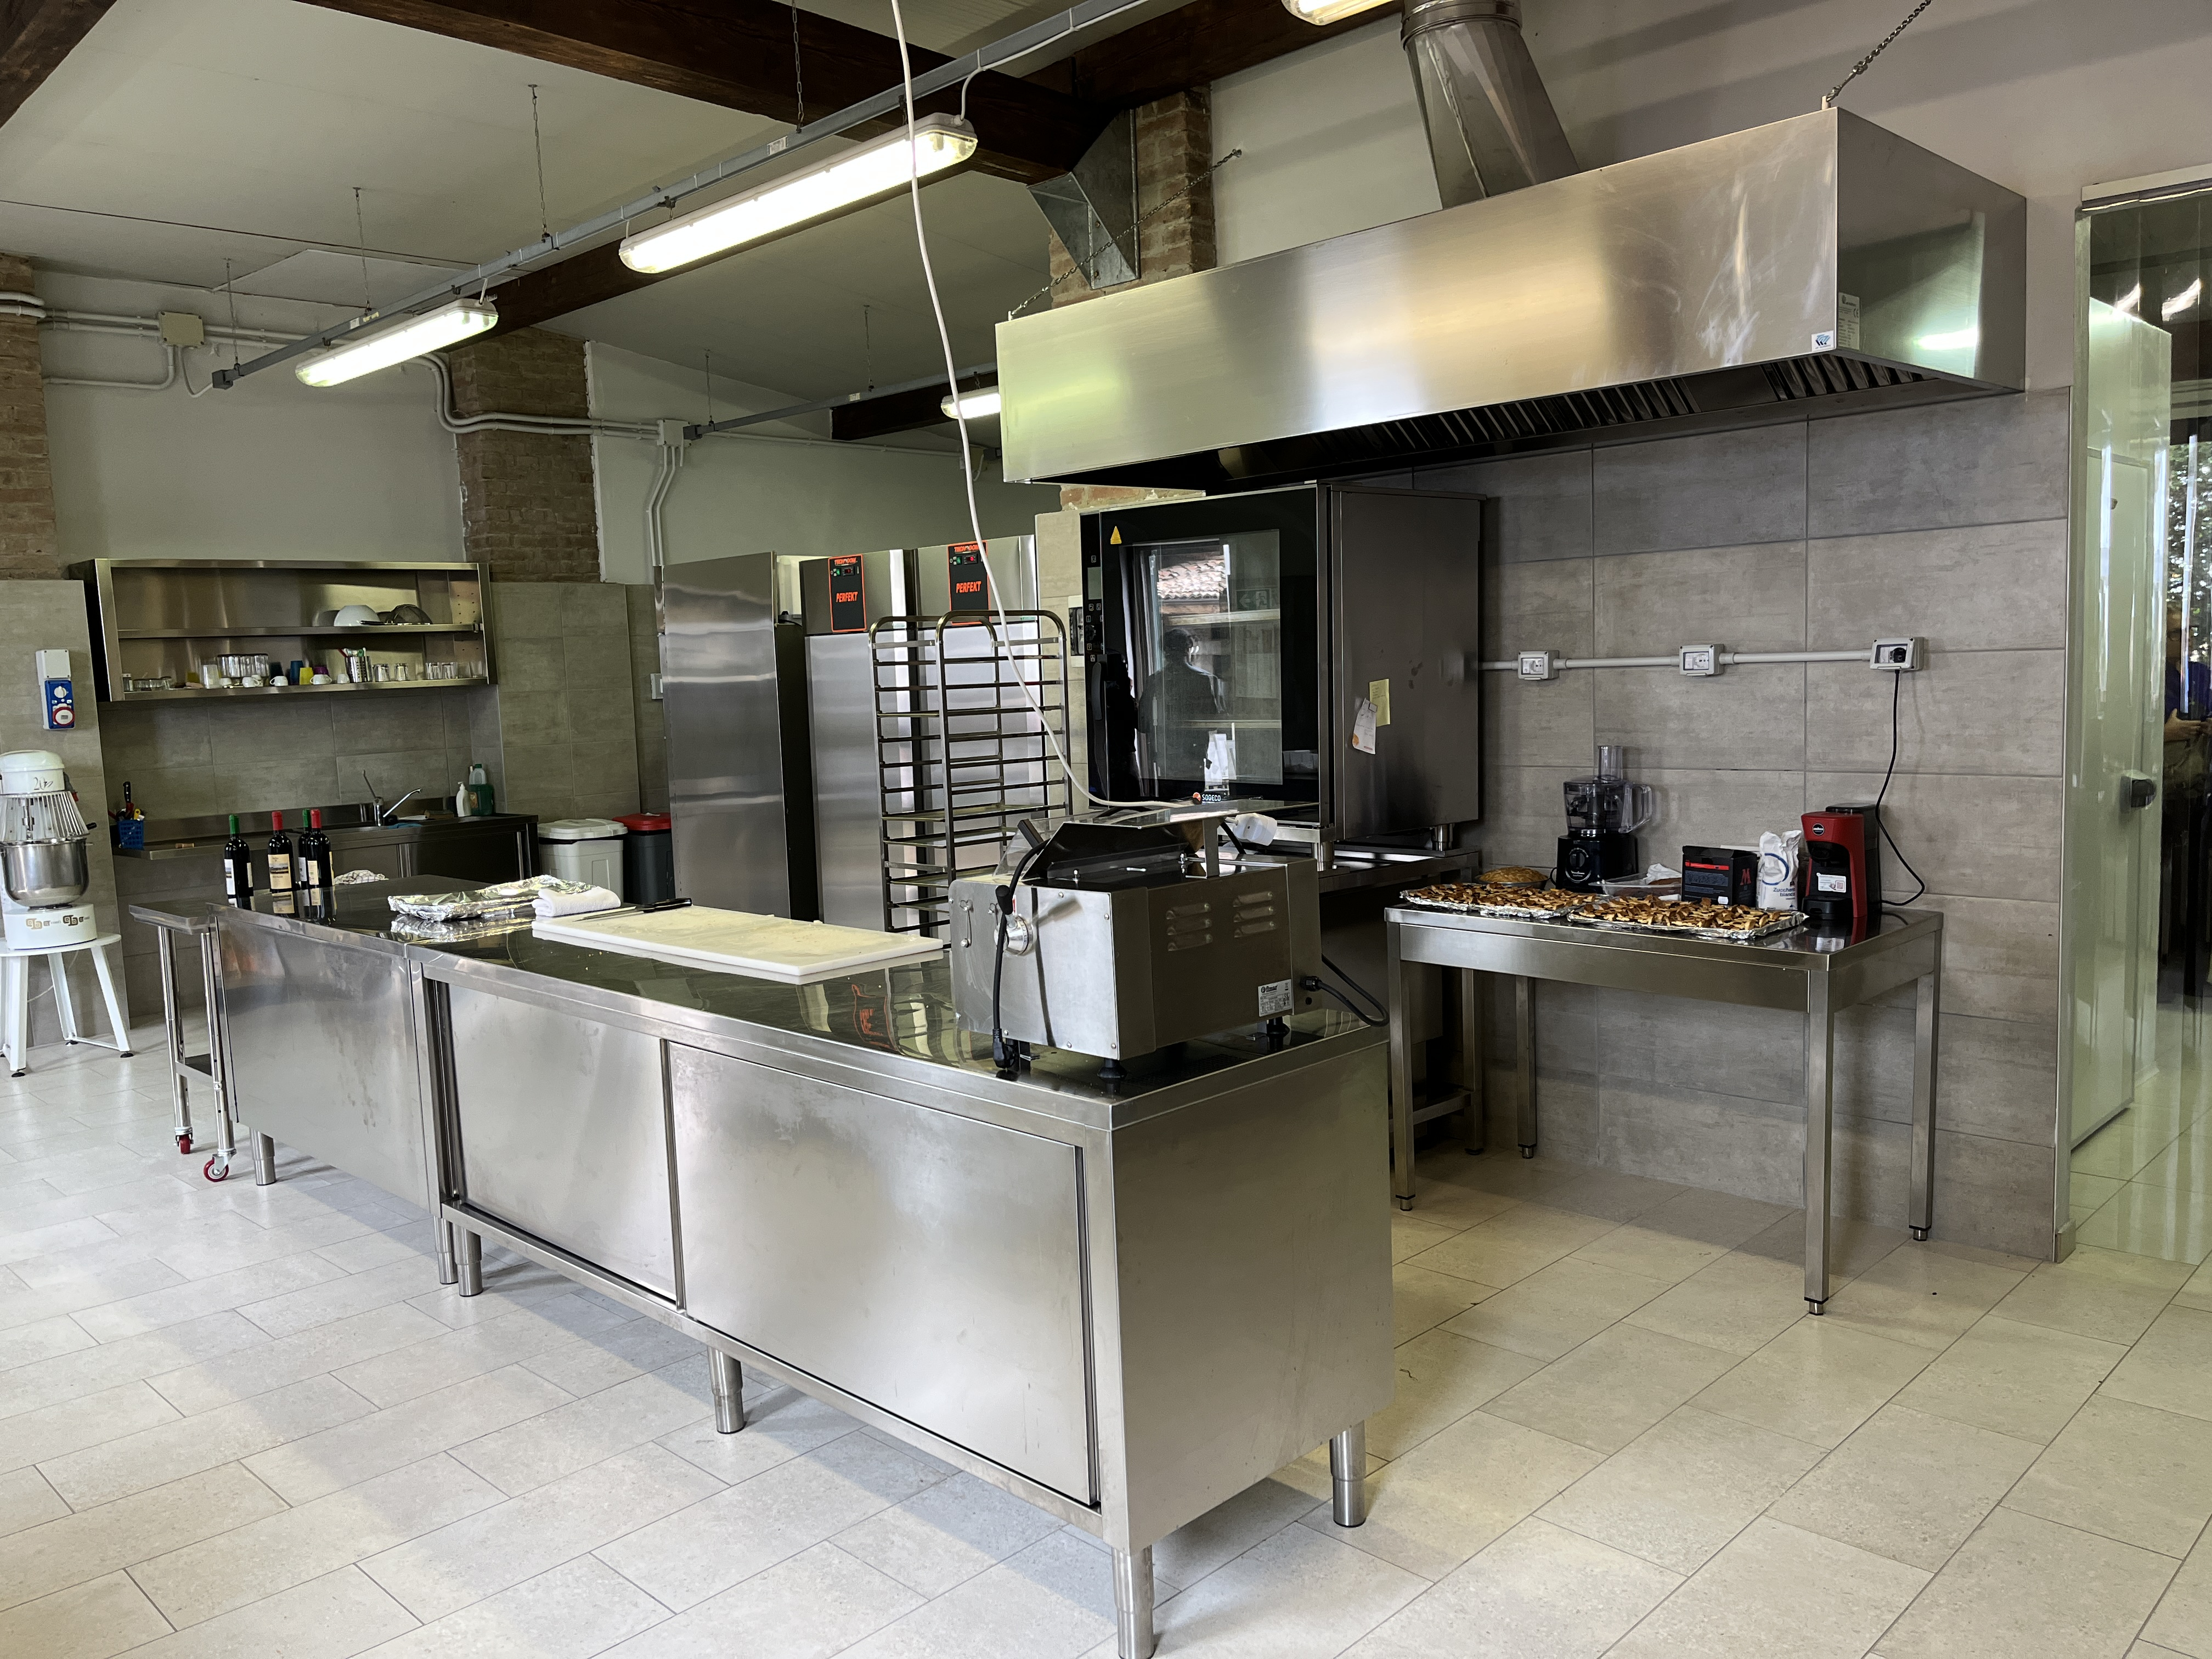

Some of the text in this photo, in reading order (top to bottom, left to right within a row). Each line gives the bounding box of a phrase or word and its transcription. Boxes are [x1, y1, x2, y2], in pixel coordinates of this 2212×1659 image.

[956, 581, 981, 594] PERFEKT
[836, 591, 859, 603] PERFEKT
[1740, 868, 1752, 885] M
